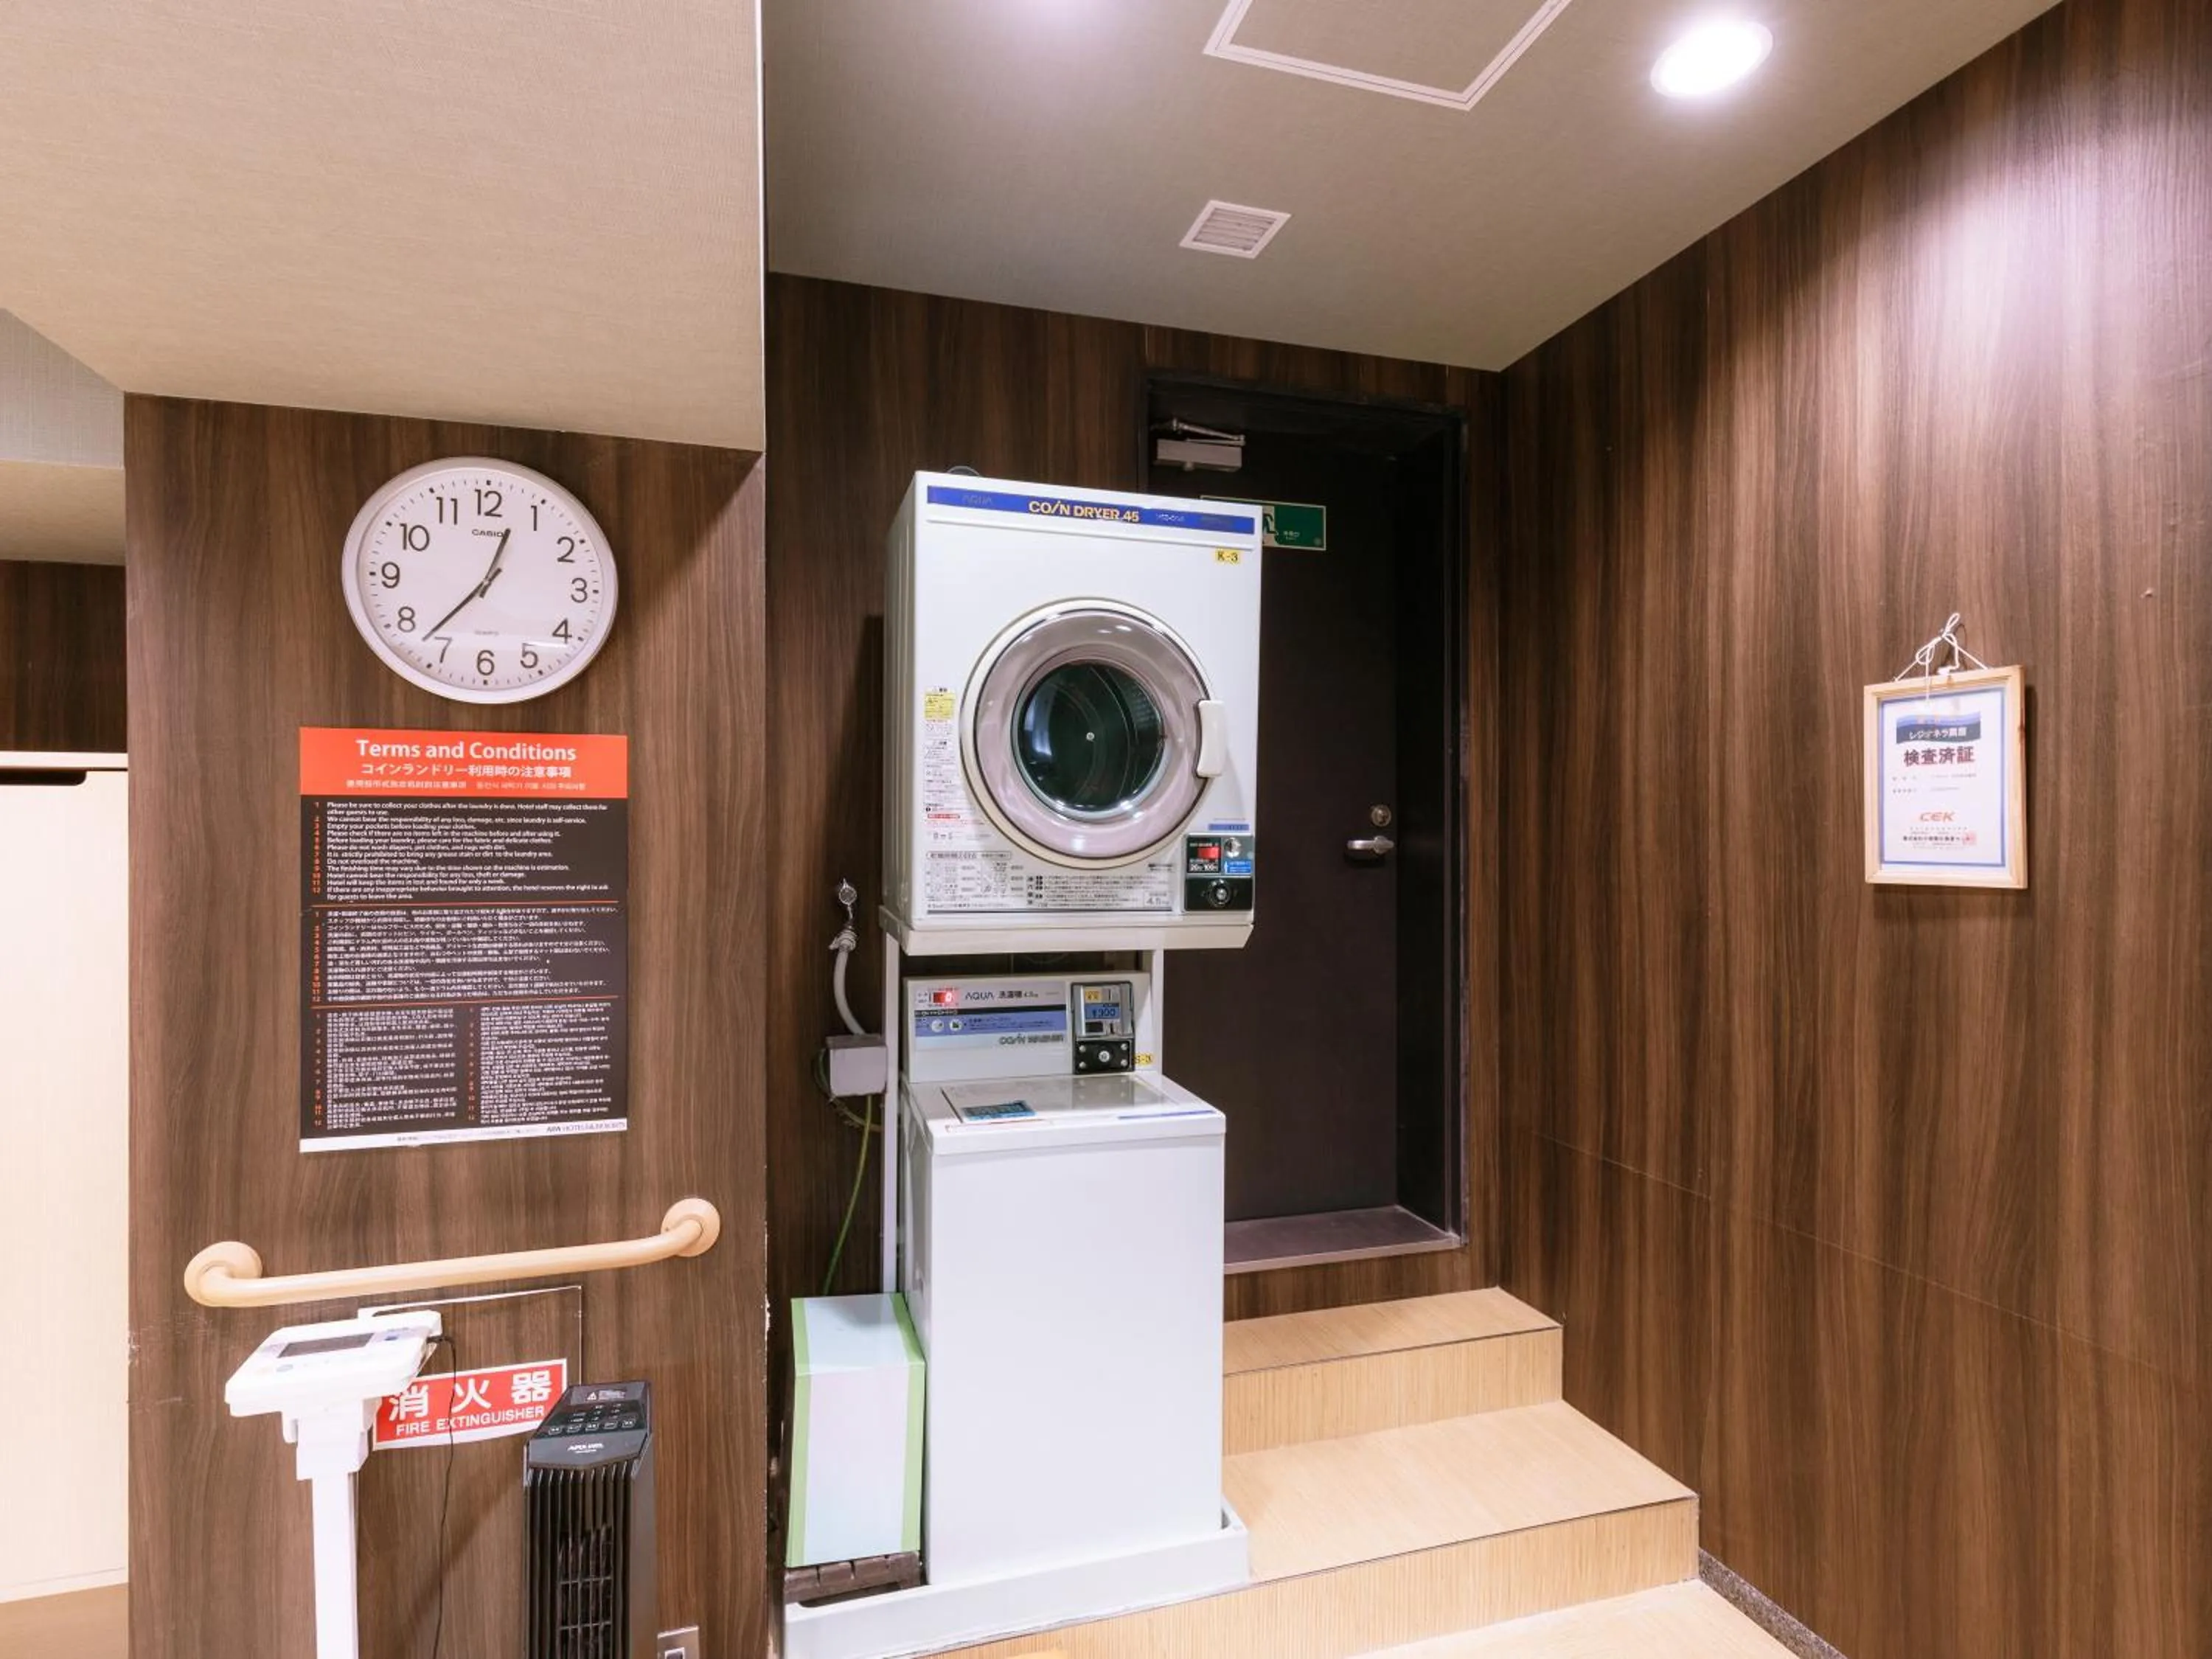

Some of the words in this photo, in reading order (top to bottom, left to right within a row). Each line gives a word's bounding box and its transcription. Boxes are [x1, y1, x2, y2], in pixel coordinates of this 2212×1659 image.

[436, 497, 458, 525] 11
[474, 489, 503, 518] 12
[1074, 505, 1119, 520] DRYER
[1122, 510, 1139, 523] 45
[530, 504, 538, 531] 1
[399, 523, 430, 552] 10
[557, 536, 575, 563] 2
[1217, 551, 1239, 563] K-3
[381, 561, 400, 588] 9
[571, 577, 588, 603] 3
[397, 606, 416, 633] 8
[552, 619, 572, 644] 4
[434, 636, 453, 664] 7
[476, 650, 495, 675] 6
[520, 643, 538, 669] 5
[356, 739, 420, 758] Terms
[425, 740, 465, 759] and
[470, 742, 577, 762] Conditions
[1904, 746, 1976, 767] 検査済証
[361, 762, 572, 779] コインランドリー利用時の注意事項
[965, 992, 995, 1001] AQUA
[389, 1370, 552, 1422] 消火器
[396, 1420, 430, 1436] FIRE
[437, 1405, 545, 1430] EXTINGUISHER
